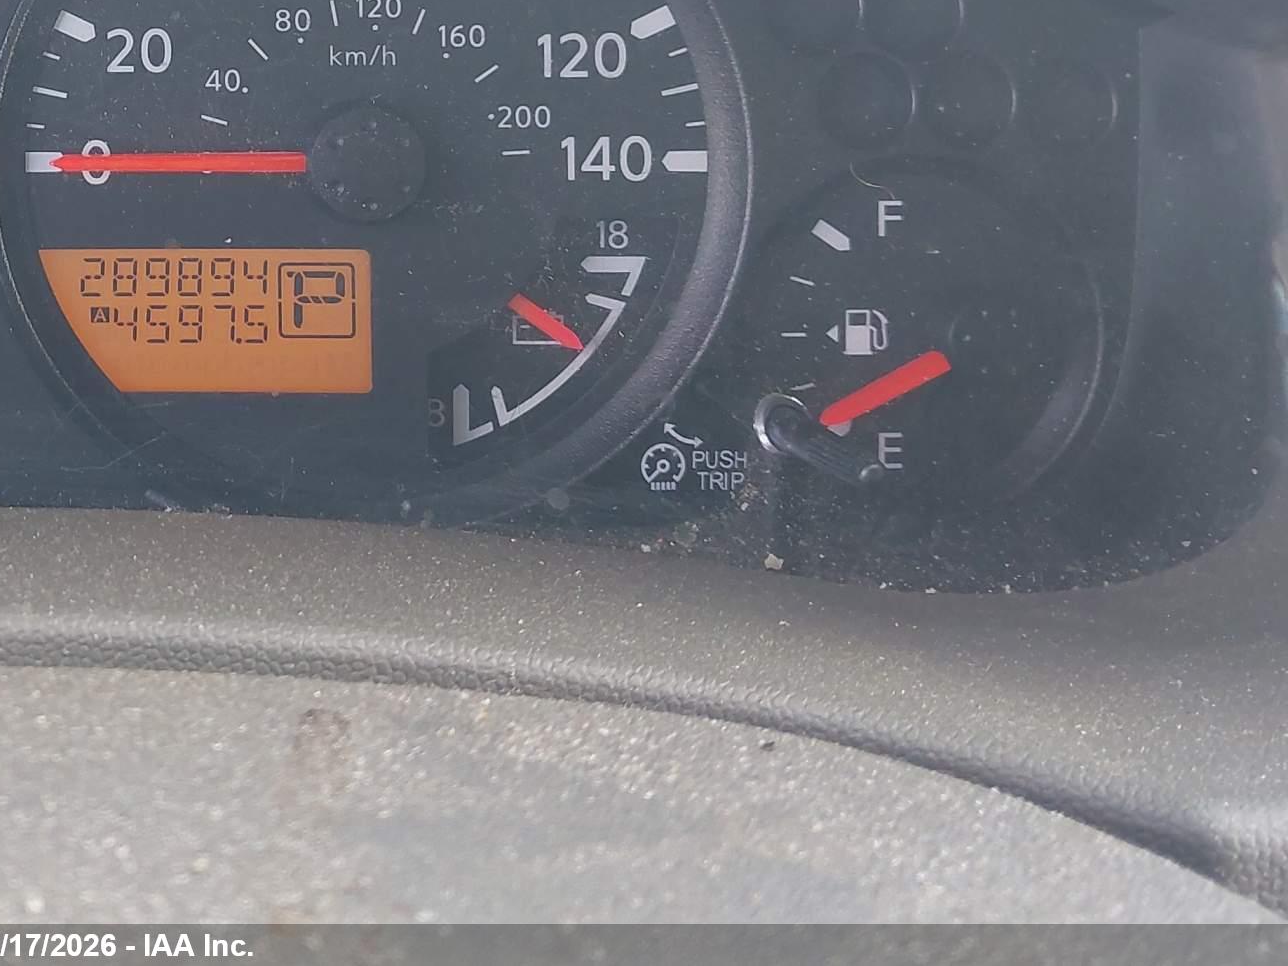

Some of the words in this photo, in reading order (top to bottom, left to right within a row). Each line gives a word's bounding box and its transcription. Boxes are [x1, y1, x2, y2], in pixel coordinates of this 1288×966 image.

[275, 8, 311, 33] 80
[440, 24, 486, 49] 160
[106, 28, 172, 74] 20
[328, 44, 397, 69] km/h
[537, 34, 627, 79] 120
[204, 70, 240, 94] 40
[497, 106, 550, 129] 200
[561, 135, 652, 182] 140
[597, 220, 629, 249] 18
[878, 200, 904, 237] F
[80, 257, 268, 297] 289894
[286, 271, 346, 329] P
[114, 305, 268, 344] 4597.5
[692, 450, 748, 470] PUSH
[878, 433, 904, 469] E
[697, 471, 746, 491] TRIP
